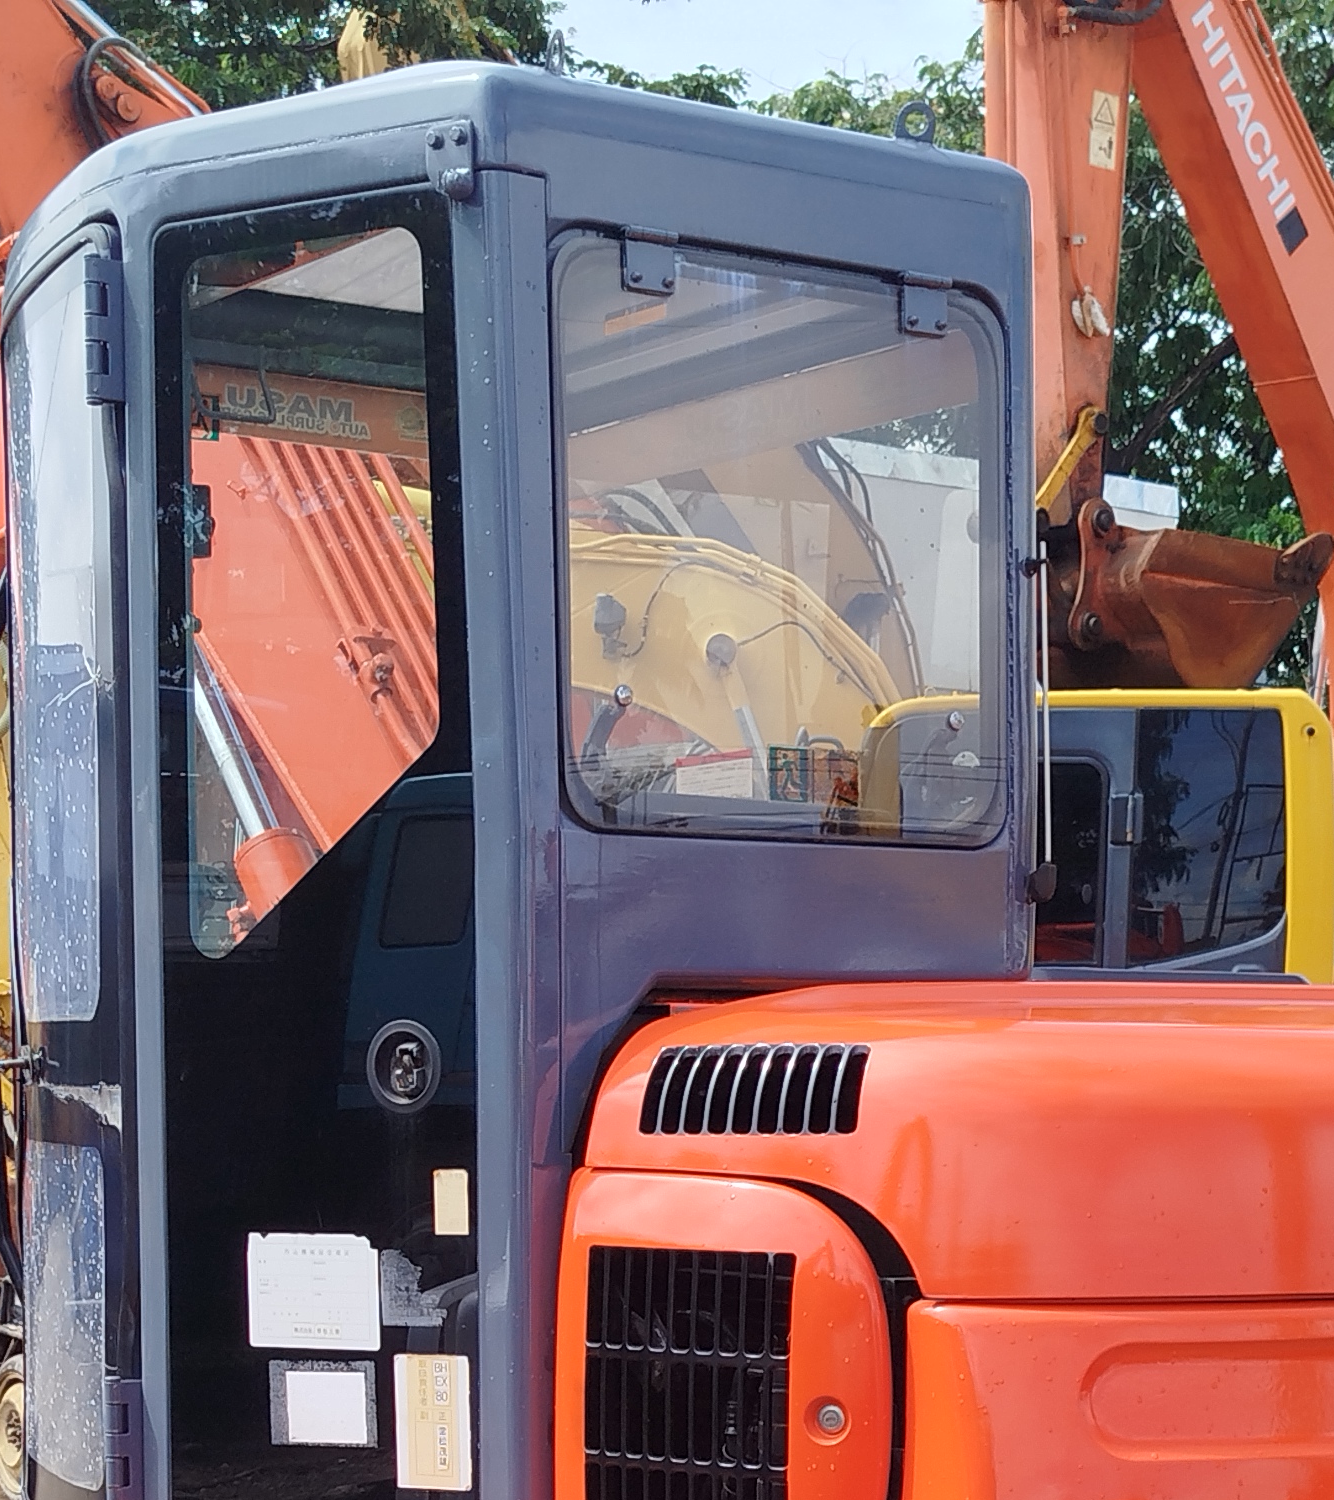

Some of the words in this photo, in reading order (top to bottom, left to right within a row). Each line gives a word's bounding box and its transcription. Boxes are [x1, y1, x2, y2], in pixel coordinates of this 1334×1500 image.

[1191, 0, 1297, 221] HITACHI
[434, 1362, 448, 1374] BH
[434, 1375, 448, 1387] EX
